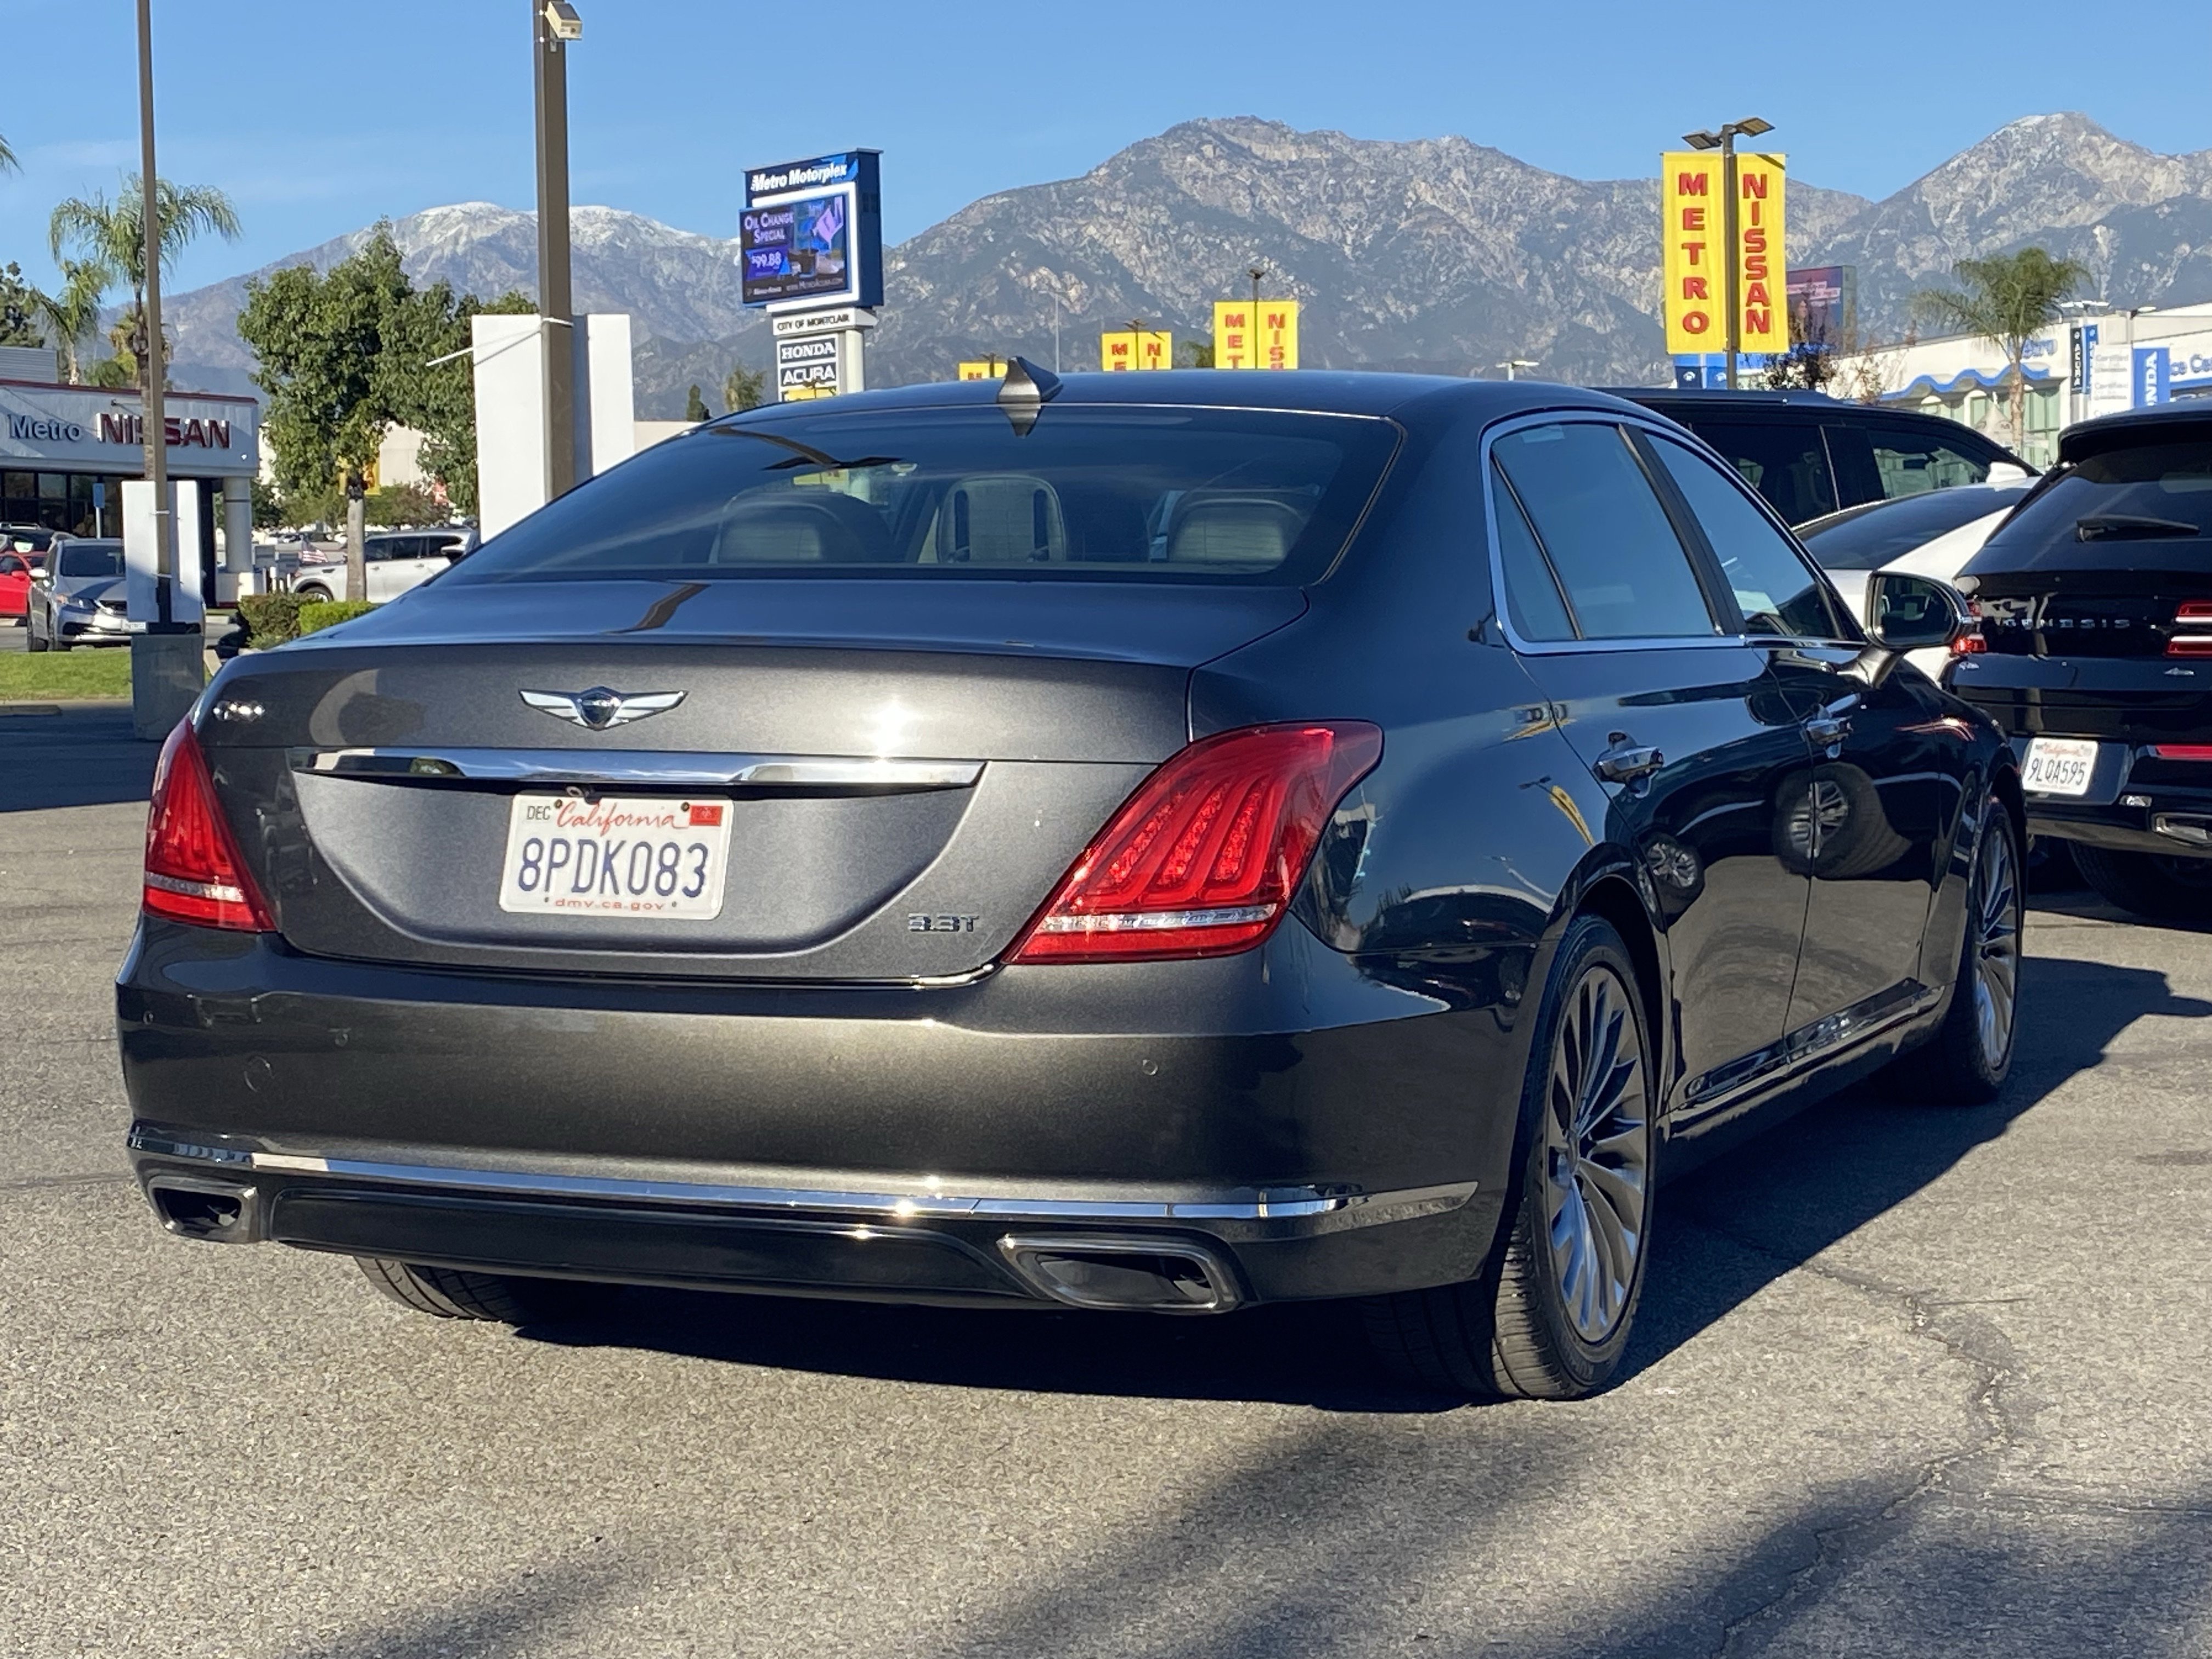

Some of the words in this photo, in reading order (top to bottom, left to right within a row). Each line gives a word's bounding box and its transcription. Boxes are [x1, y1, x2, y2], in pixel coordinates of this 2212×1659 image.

[751, 172, 787, 191] Metro
[789, 162, 847, 186] Motorplex
[1678, 172, 1710, 335] METRO
[1743, 173, 1771, 335] NISSAN
[777, 321, 792, 330] CITY
[795, 319, 804, 329] OF
[781, 342, 835, 359] HONDA
[782, 365, 835, 385] ACURA
[7, 413, 82, 442] Metro
[527, 805, 551, 821] DEC
[556, 800, 690, 837] California
[518, 837, 709, 898] 8PDK083
[555, 898, 666, 911] dmv.ca.gov
[907, 912, 980, 932] 3.3T
